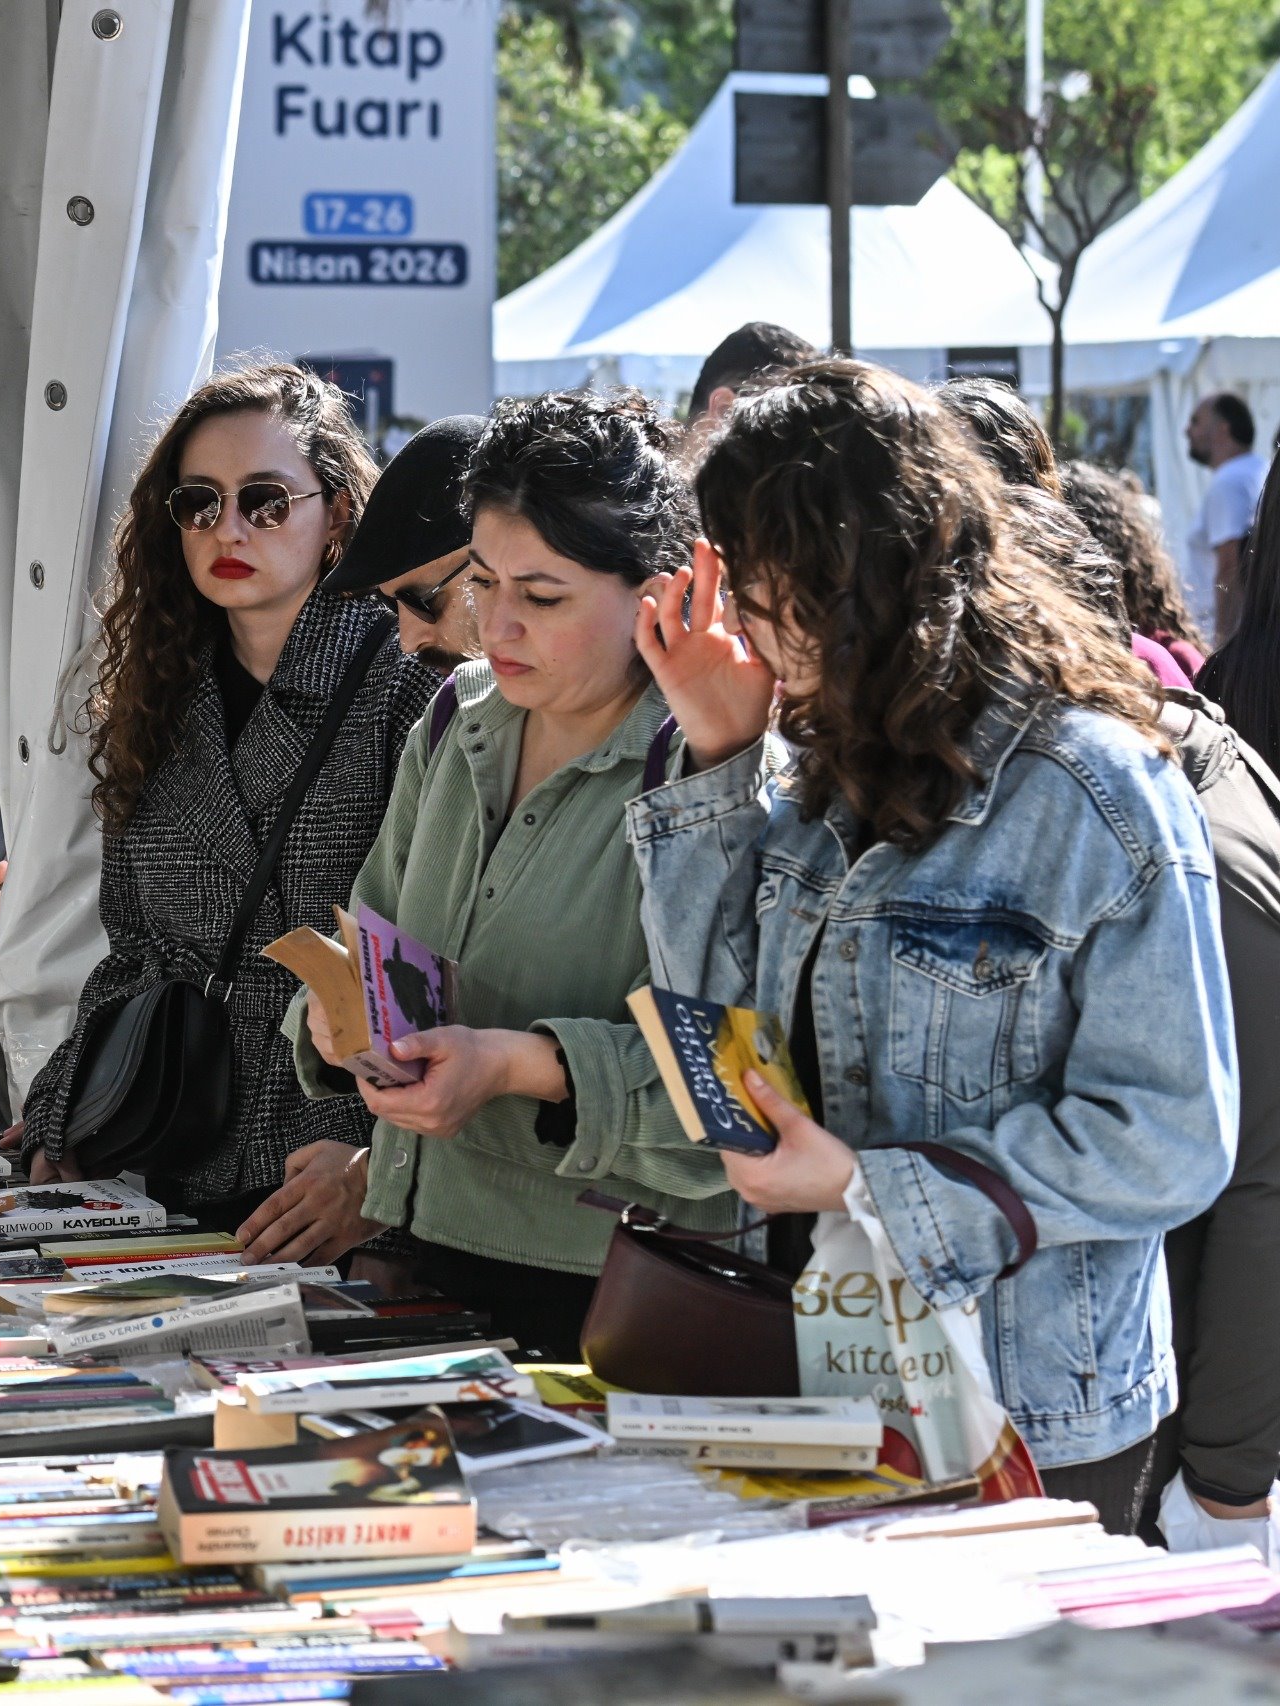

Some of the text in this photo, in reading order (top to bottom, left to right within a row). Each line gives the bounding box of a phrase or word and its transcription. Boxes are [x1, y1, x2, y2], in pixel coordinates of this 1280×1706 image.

[273, 13, 444, 82] Kitap
[275, 85, 440, 139] Fuarı
[312, 200, 407, 231] 17-26
[258, 248, 458, 281] Nisan 2026
[676, 1003, 733, 1130] COELHO
[63, 1216, 141, 1229] KAYBOLUŞ
[116, 1264, 166, 1274] 1000
[191, 1300, 239, 1317] YOLCULUK
[71, 1331, 106, 1347] JULES
[108, 1321, 148, 1337] VERNE
